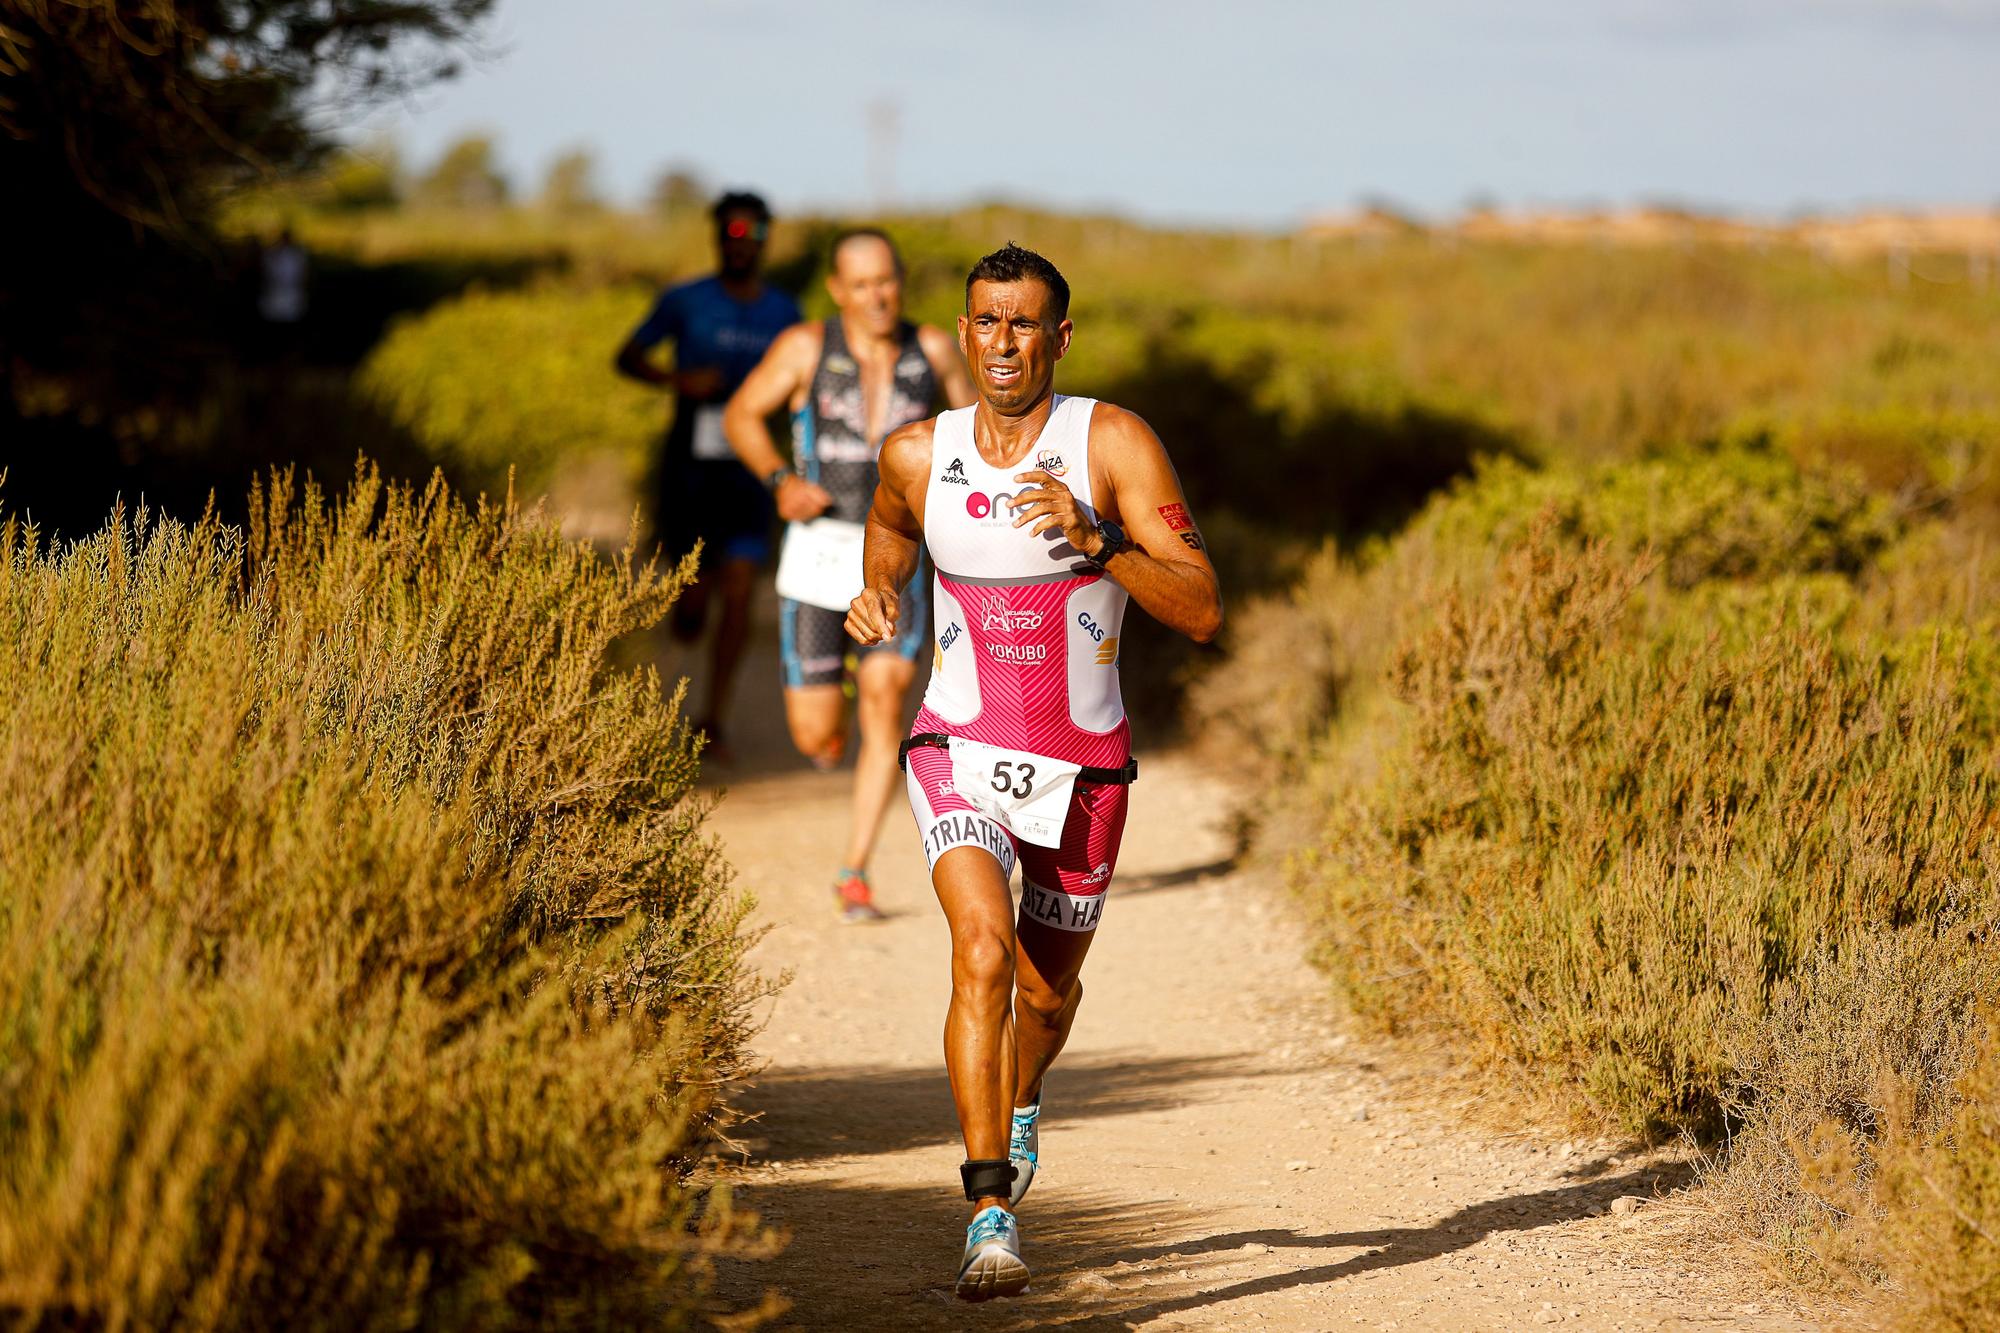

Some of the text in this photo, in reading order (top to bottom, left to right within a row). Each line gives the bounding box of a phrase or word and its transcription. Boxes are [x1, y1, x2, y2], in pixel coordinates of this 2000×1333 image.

[939, 621, 962, 651] IBIZA
[1078, 612, 1104, 642] GAS
[985, 642, 1046, 660] YOKUBO
[990, 761, 1036, 800] 53
